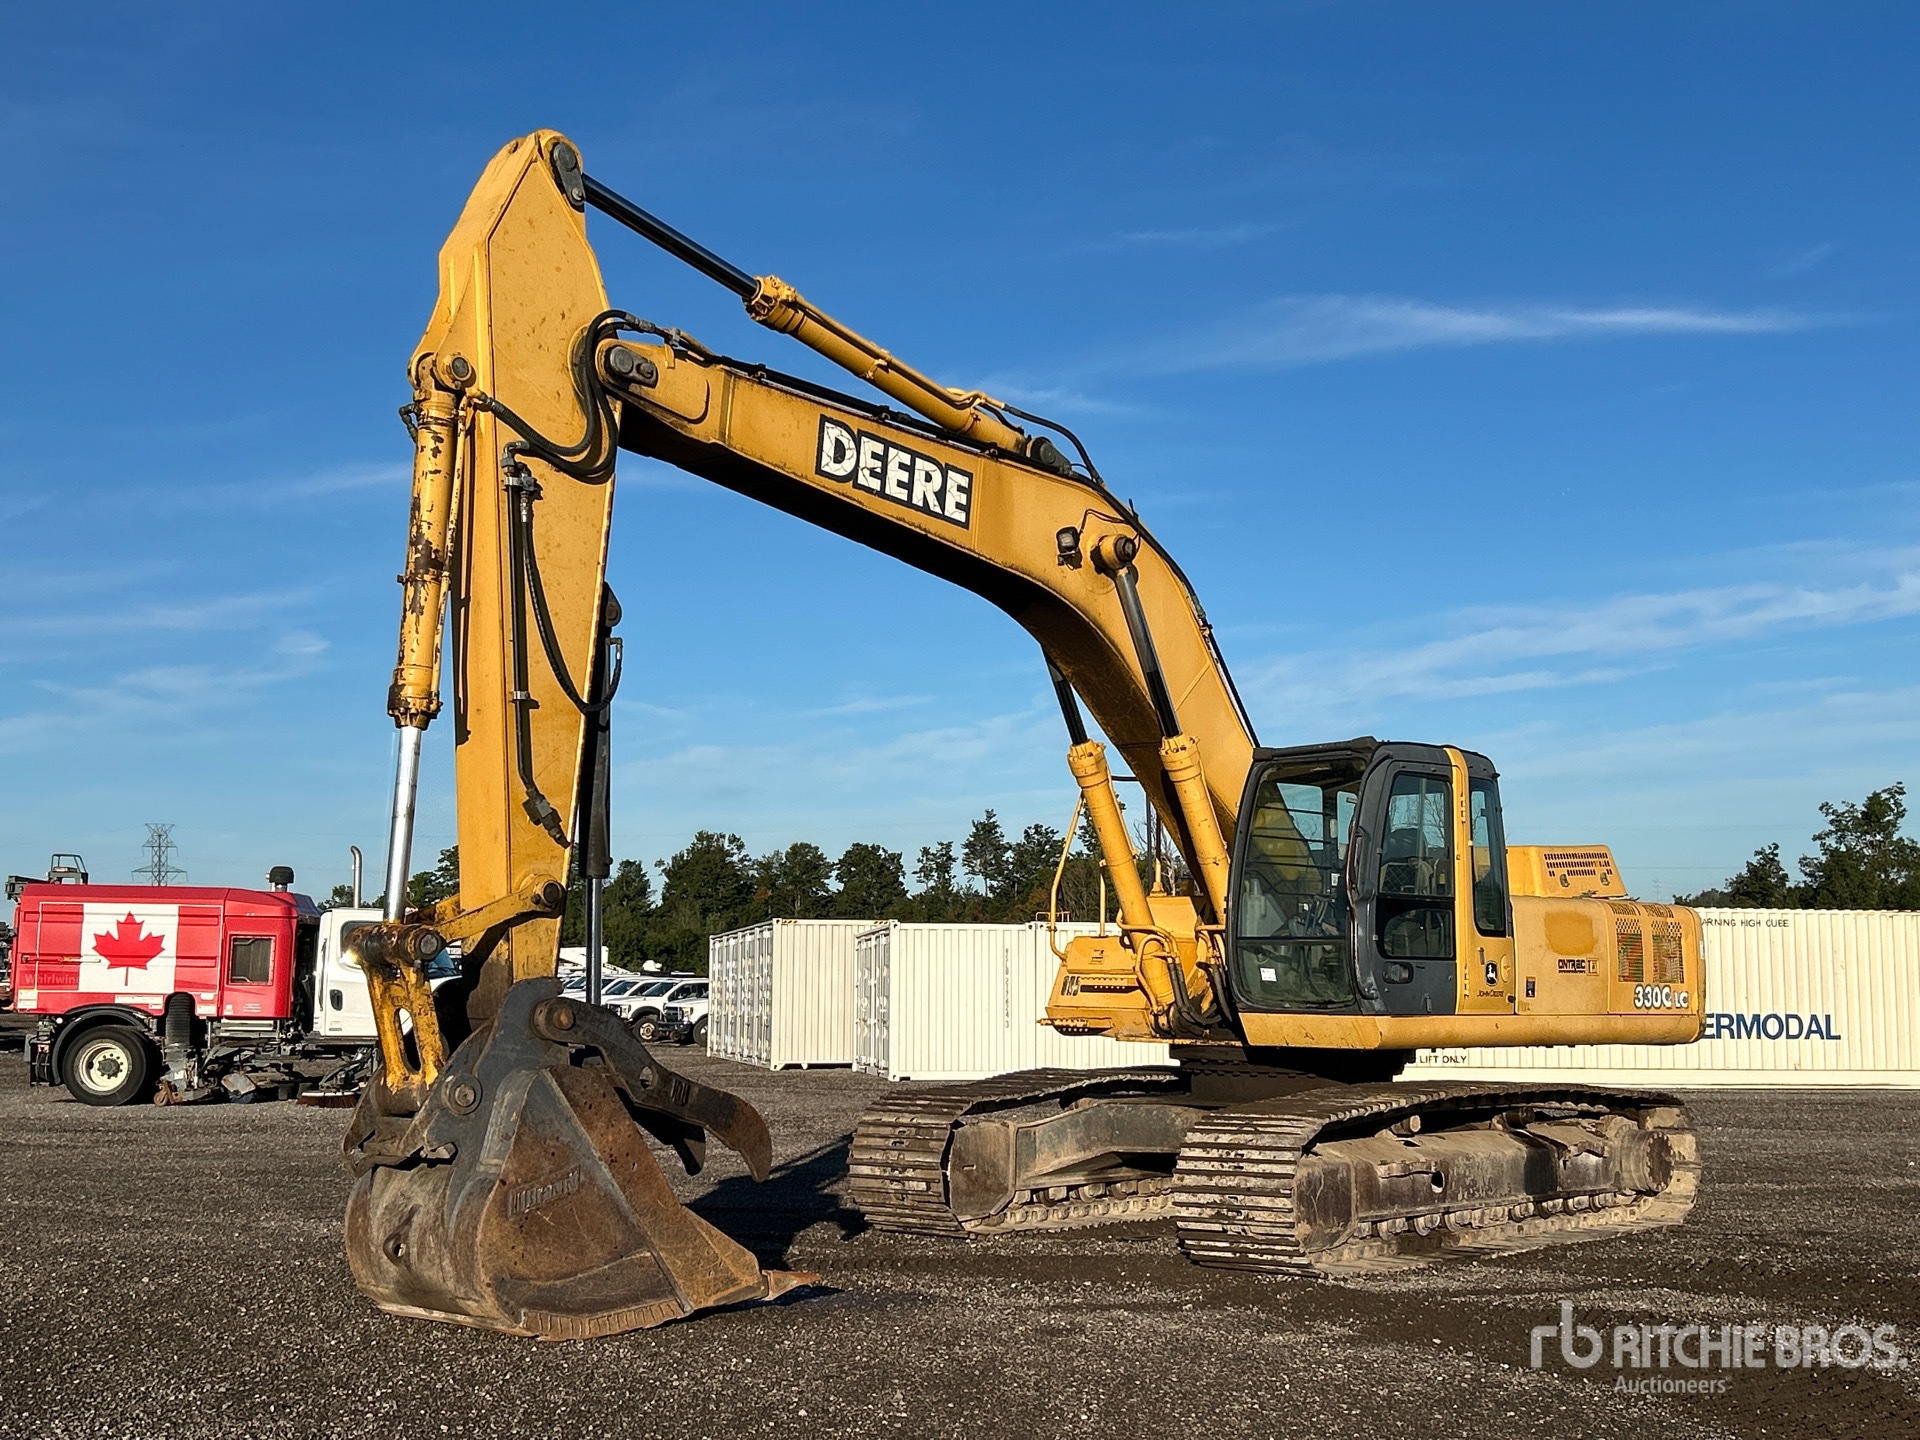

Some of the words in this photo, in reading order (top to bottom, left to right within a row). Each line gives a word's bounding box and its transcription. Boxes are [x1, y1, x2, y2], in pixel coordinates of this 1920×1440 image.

[819, 420, 971, 524] DEERE
[1740, 918, 1762, 928] HIGH
[24, 973, 79, 985] Whirlwin
[1634, 984, 1673, 1009] 330C
[1674, 991, 1690, 1009] LC
[1419, 1055, 1439, 1064] LIFT
[1442, 1055, 1467, 1064] ONLY
